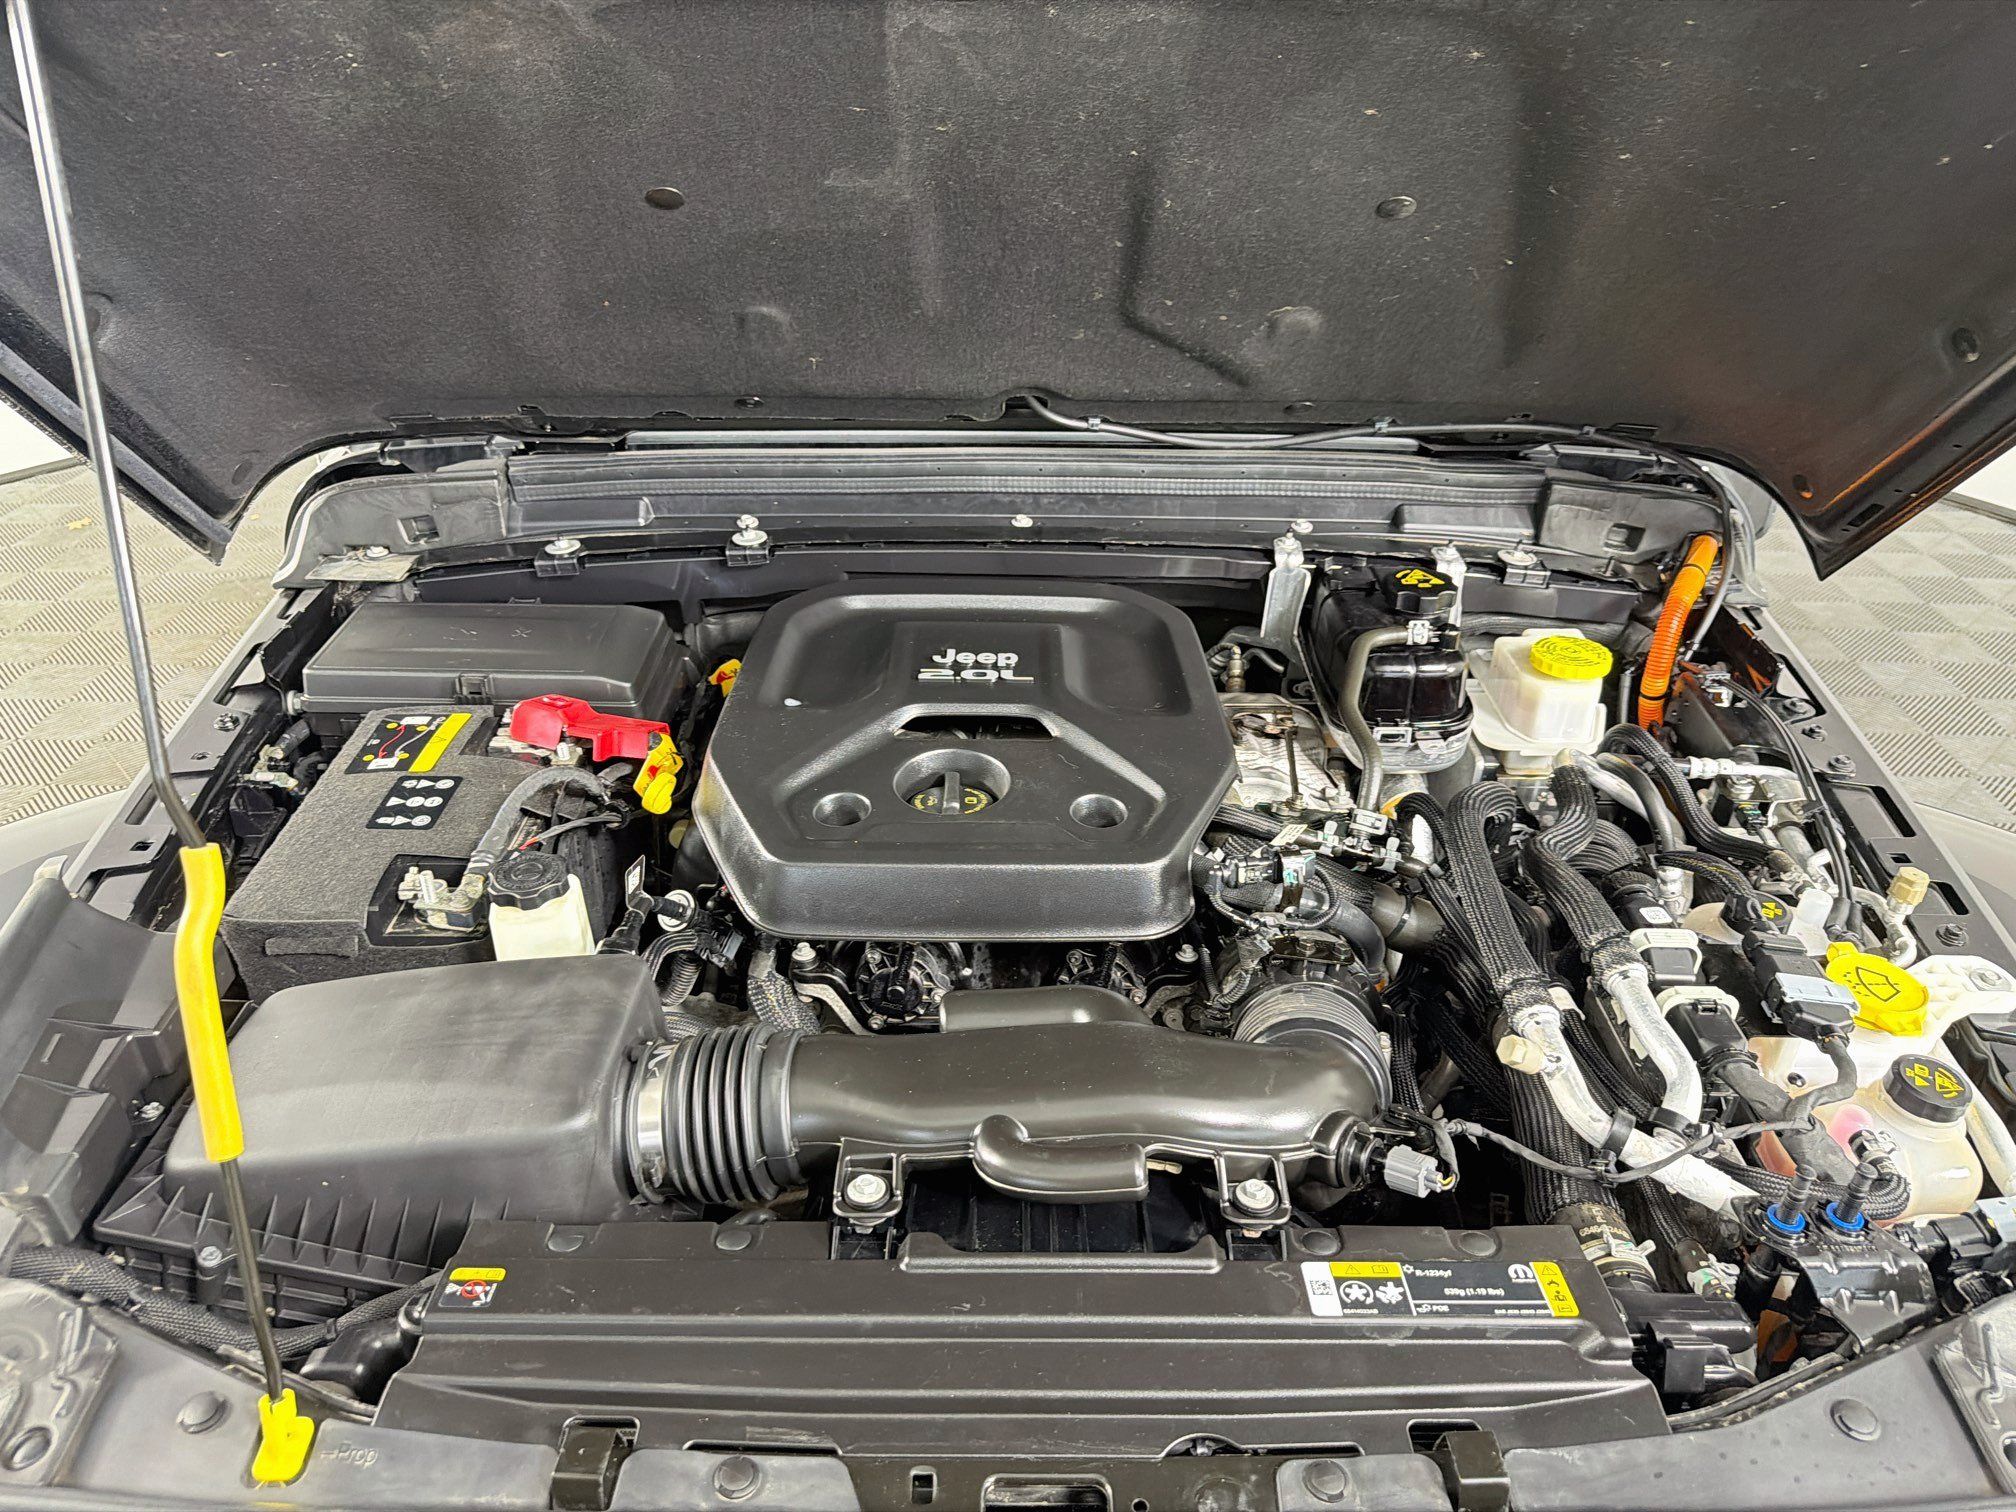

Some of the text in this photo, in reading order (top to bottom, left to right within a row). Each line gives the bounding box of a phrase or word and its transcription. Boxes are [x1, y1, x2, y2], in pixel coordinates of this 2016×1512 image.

[932, 648, 1018, 667] Jeep
[917, 668, 1034, 682] 2.0L
[336, 1441, 379, 1469] Prop
